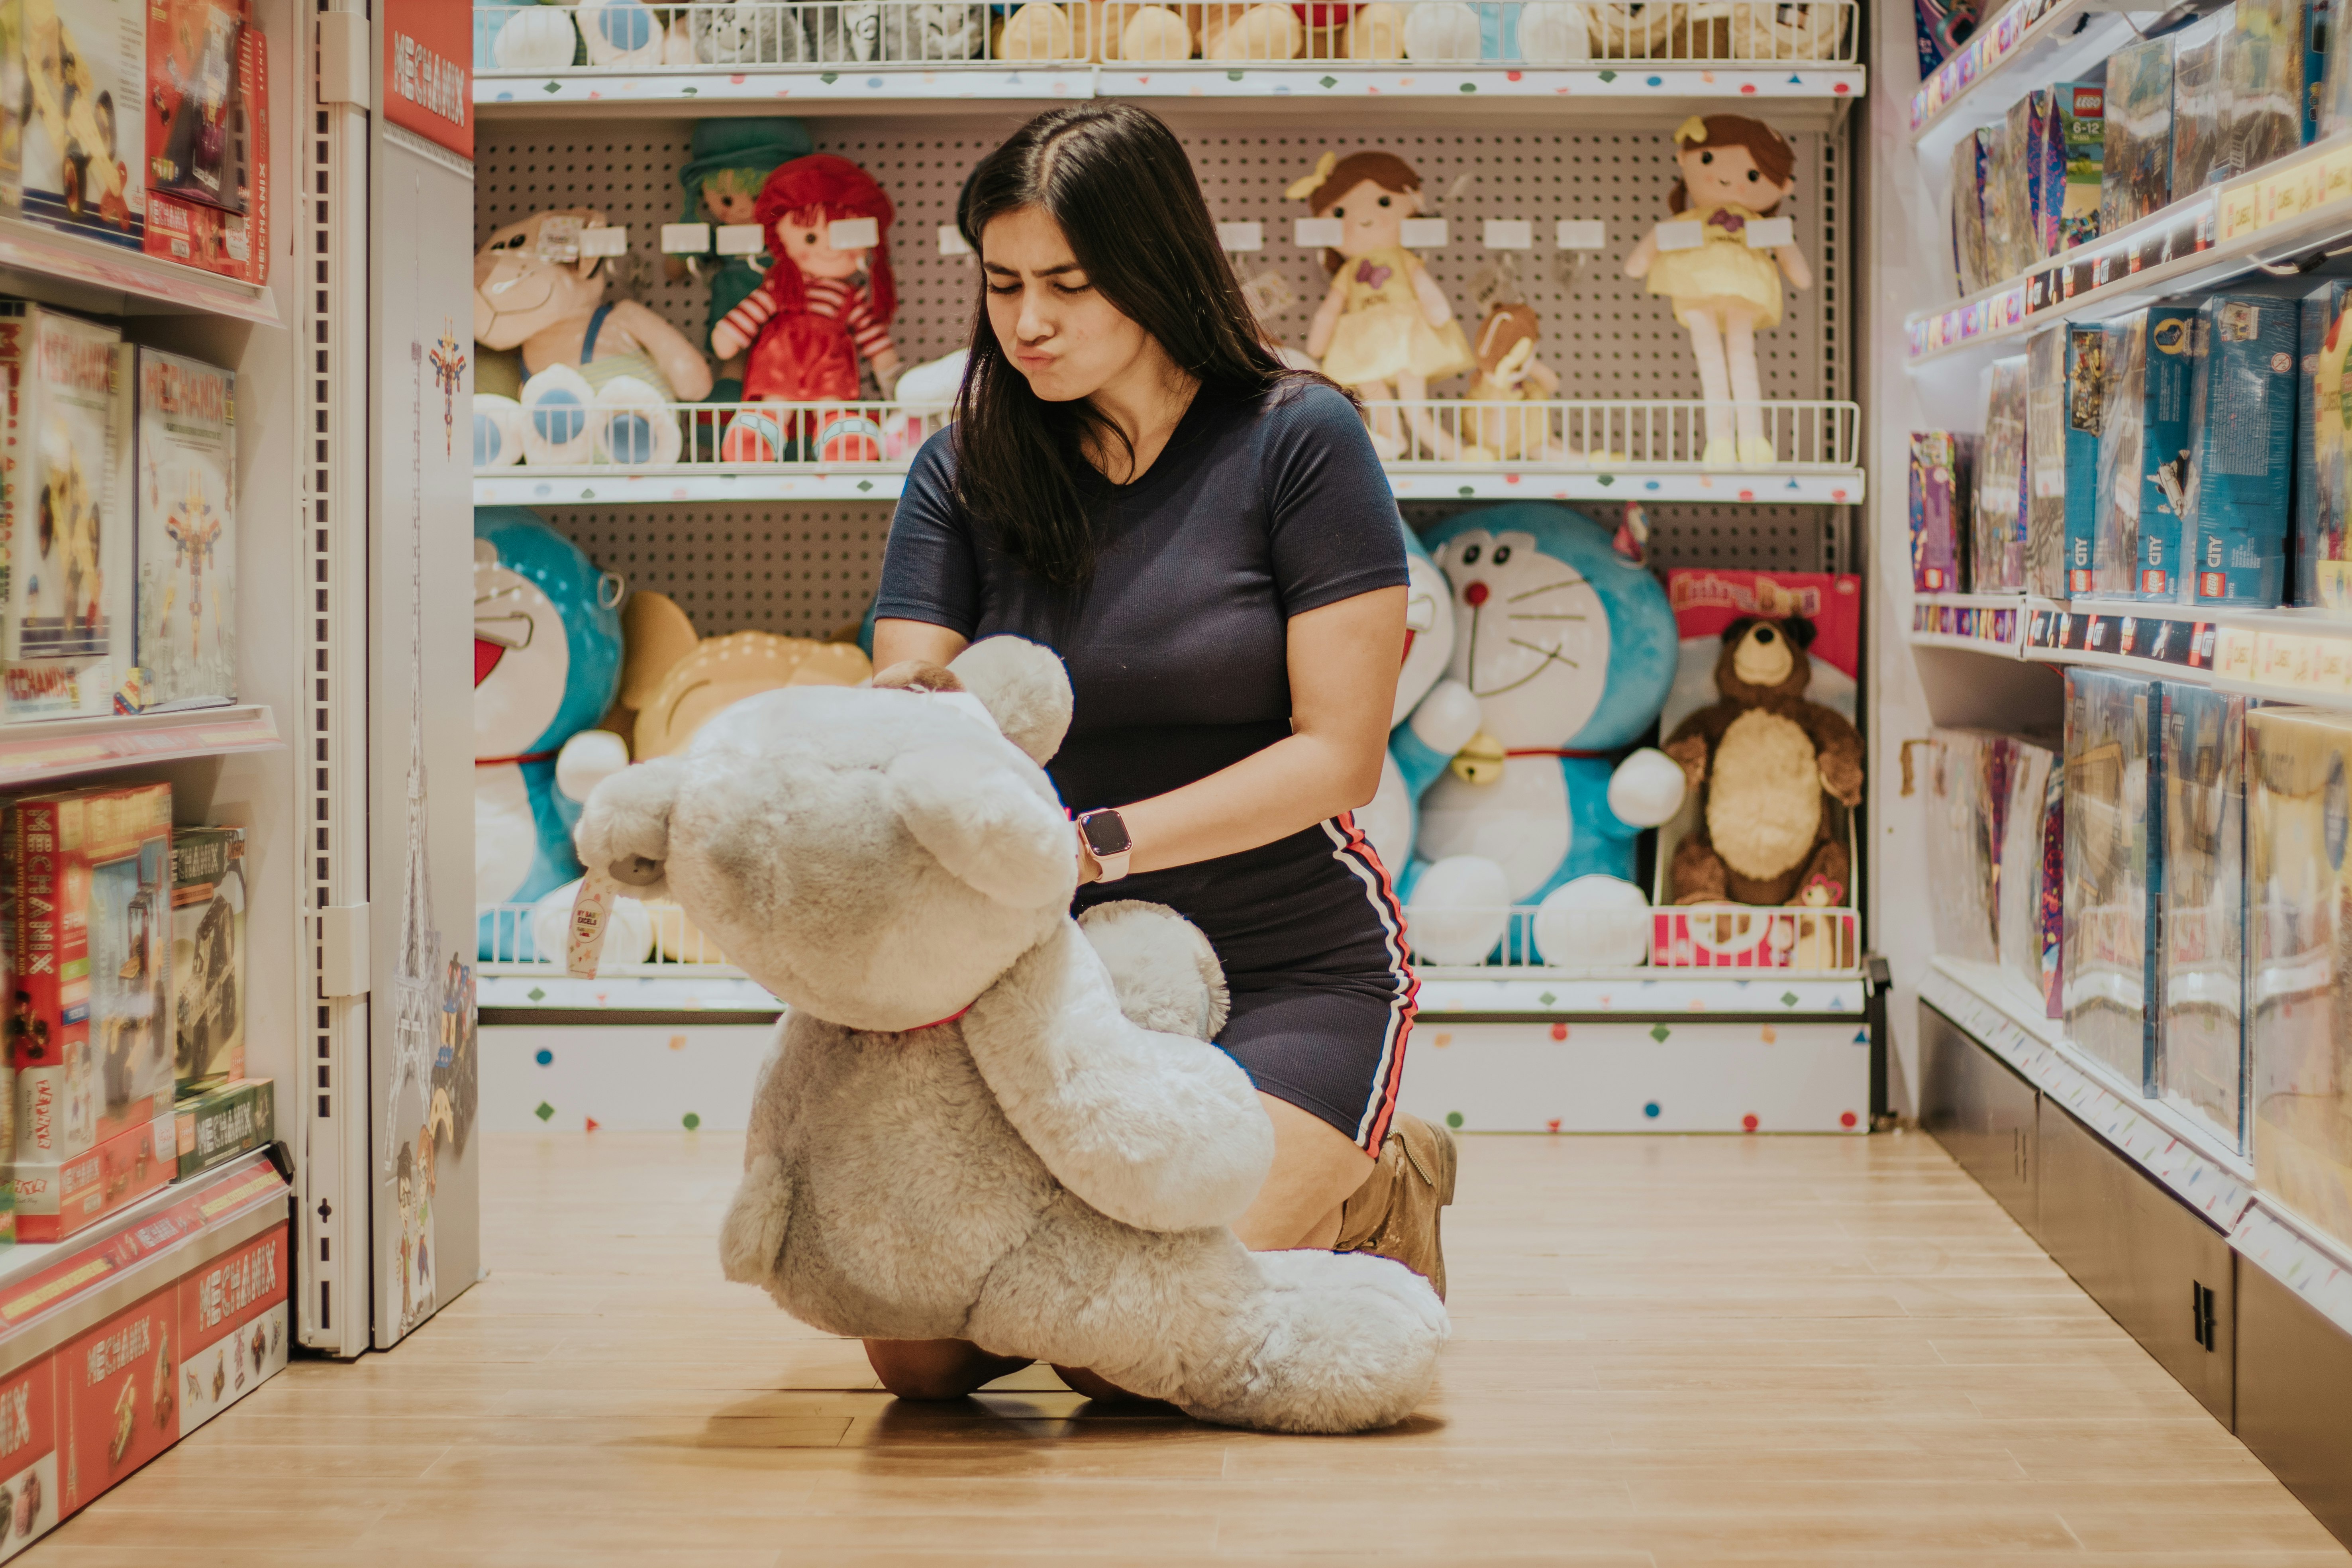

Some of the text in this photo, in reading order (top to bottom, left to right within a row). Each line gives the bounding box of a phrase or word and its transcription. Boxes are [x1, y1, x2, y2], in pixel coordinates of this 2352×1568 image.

[394, 30, 464, 128] MECHANIX
[2075, 96, 2102, 108] LEGO
[2073, 122, 2099, 134] 6-12
[145, 360, 223, 424] MECHANIX
[2075, 536, 2088, 566] CITY
[2148, 534, 2162, 566] CITY
[2207, 534, 2223, 568] CITY
[2076, 571, 2085, 590] LEGO
[2148, 571, 2159, 592] LEGO
[2207, 573, 2217, 596] LEGO
[171, 842, 218, 882] ECHANIX
[27, 809, 53, 974] MECHANIX
[578, 917, 597, 925] EXCELS
[37, 1080, 52, 1149] ZEPHYR
[197, 1101, 251, 1156] MECHANIX
[15, 1179, 47, 1195] HYR
[200, 1240, 276, 1332] MECHANIX
[87, 1315, 151, 1387] MECHANIX
